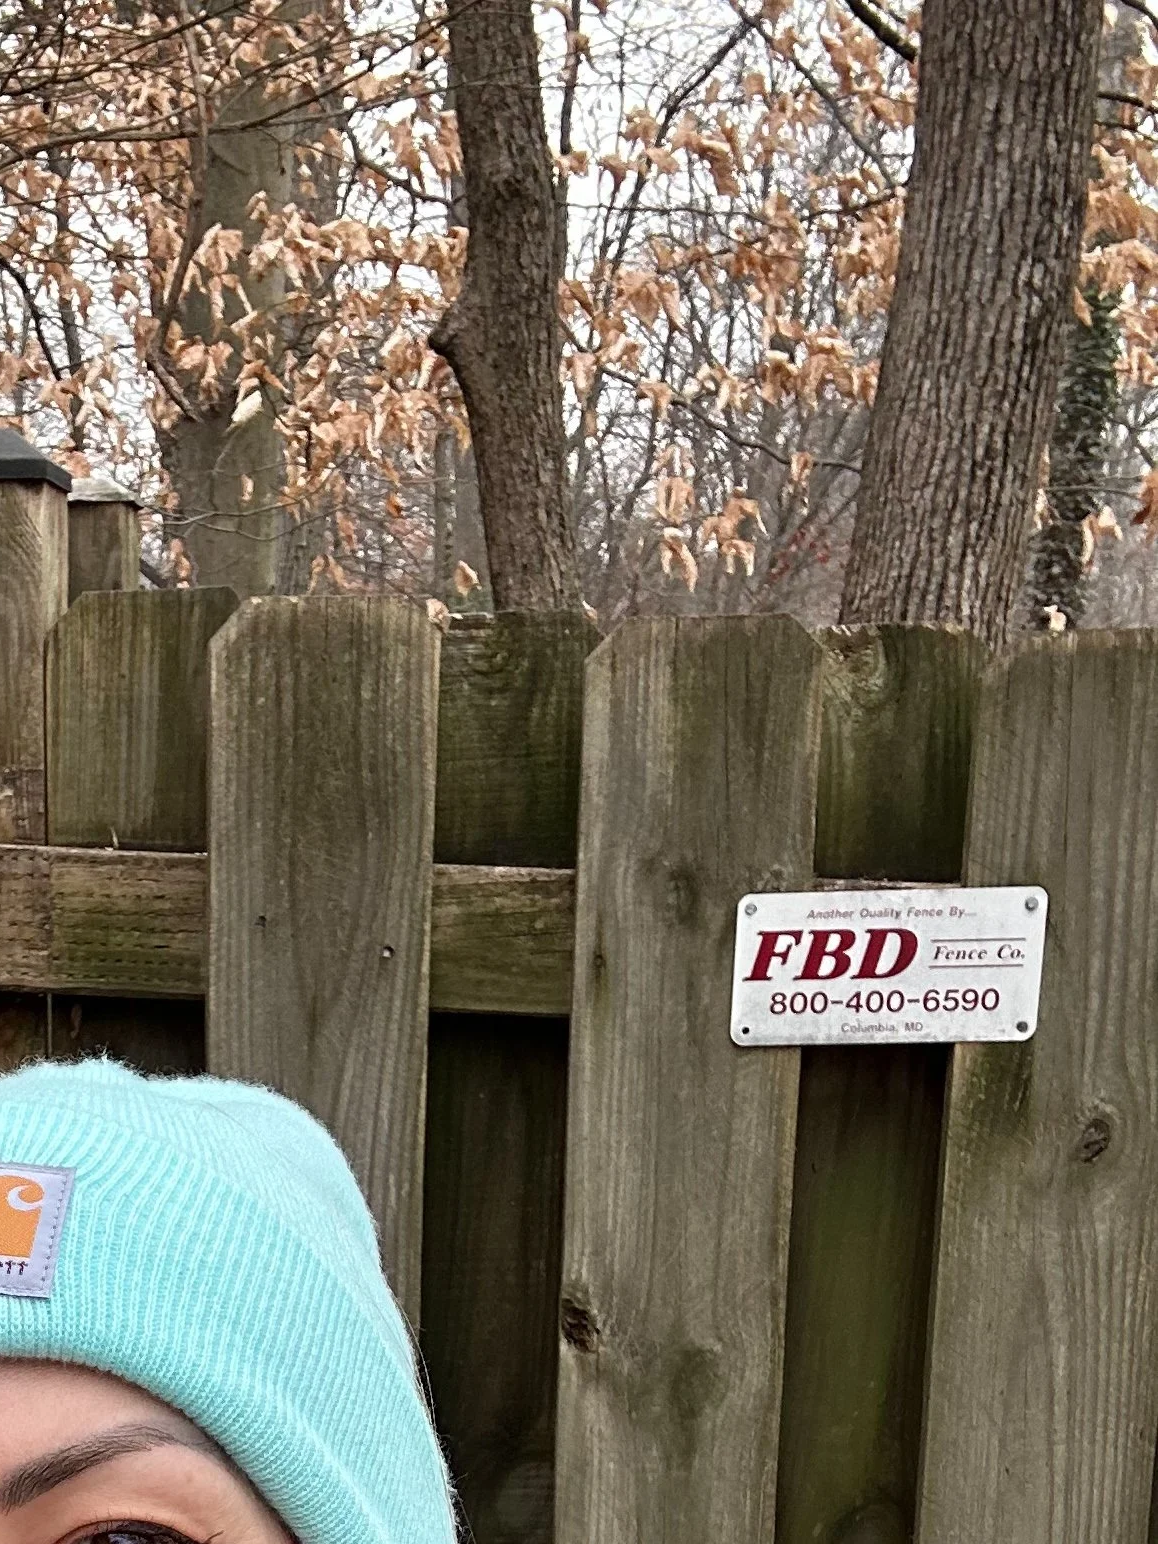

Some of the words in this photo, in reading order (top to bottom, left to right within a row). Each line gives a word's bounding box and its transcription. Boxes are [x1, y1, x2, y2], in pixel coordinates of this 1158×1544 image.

[806, 908, 855, 920] Another
[859, 907, 902, 920] Quality
[906, 906, 944, 918] Fence
[741, 926, 919, 982] FBD
[933, 944, 988, 961] Fence
[996, 943, 1026, 960] Co.
[769, 987, 1001, 1016] 800-400-6590
[904, 1021, 924, 1033] MD
